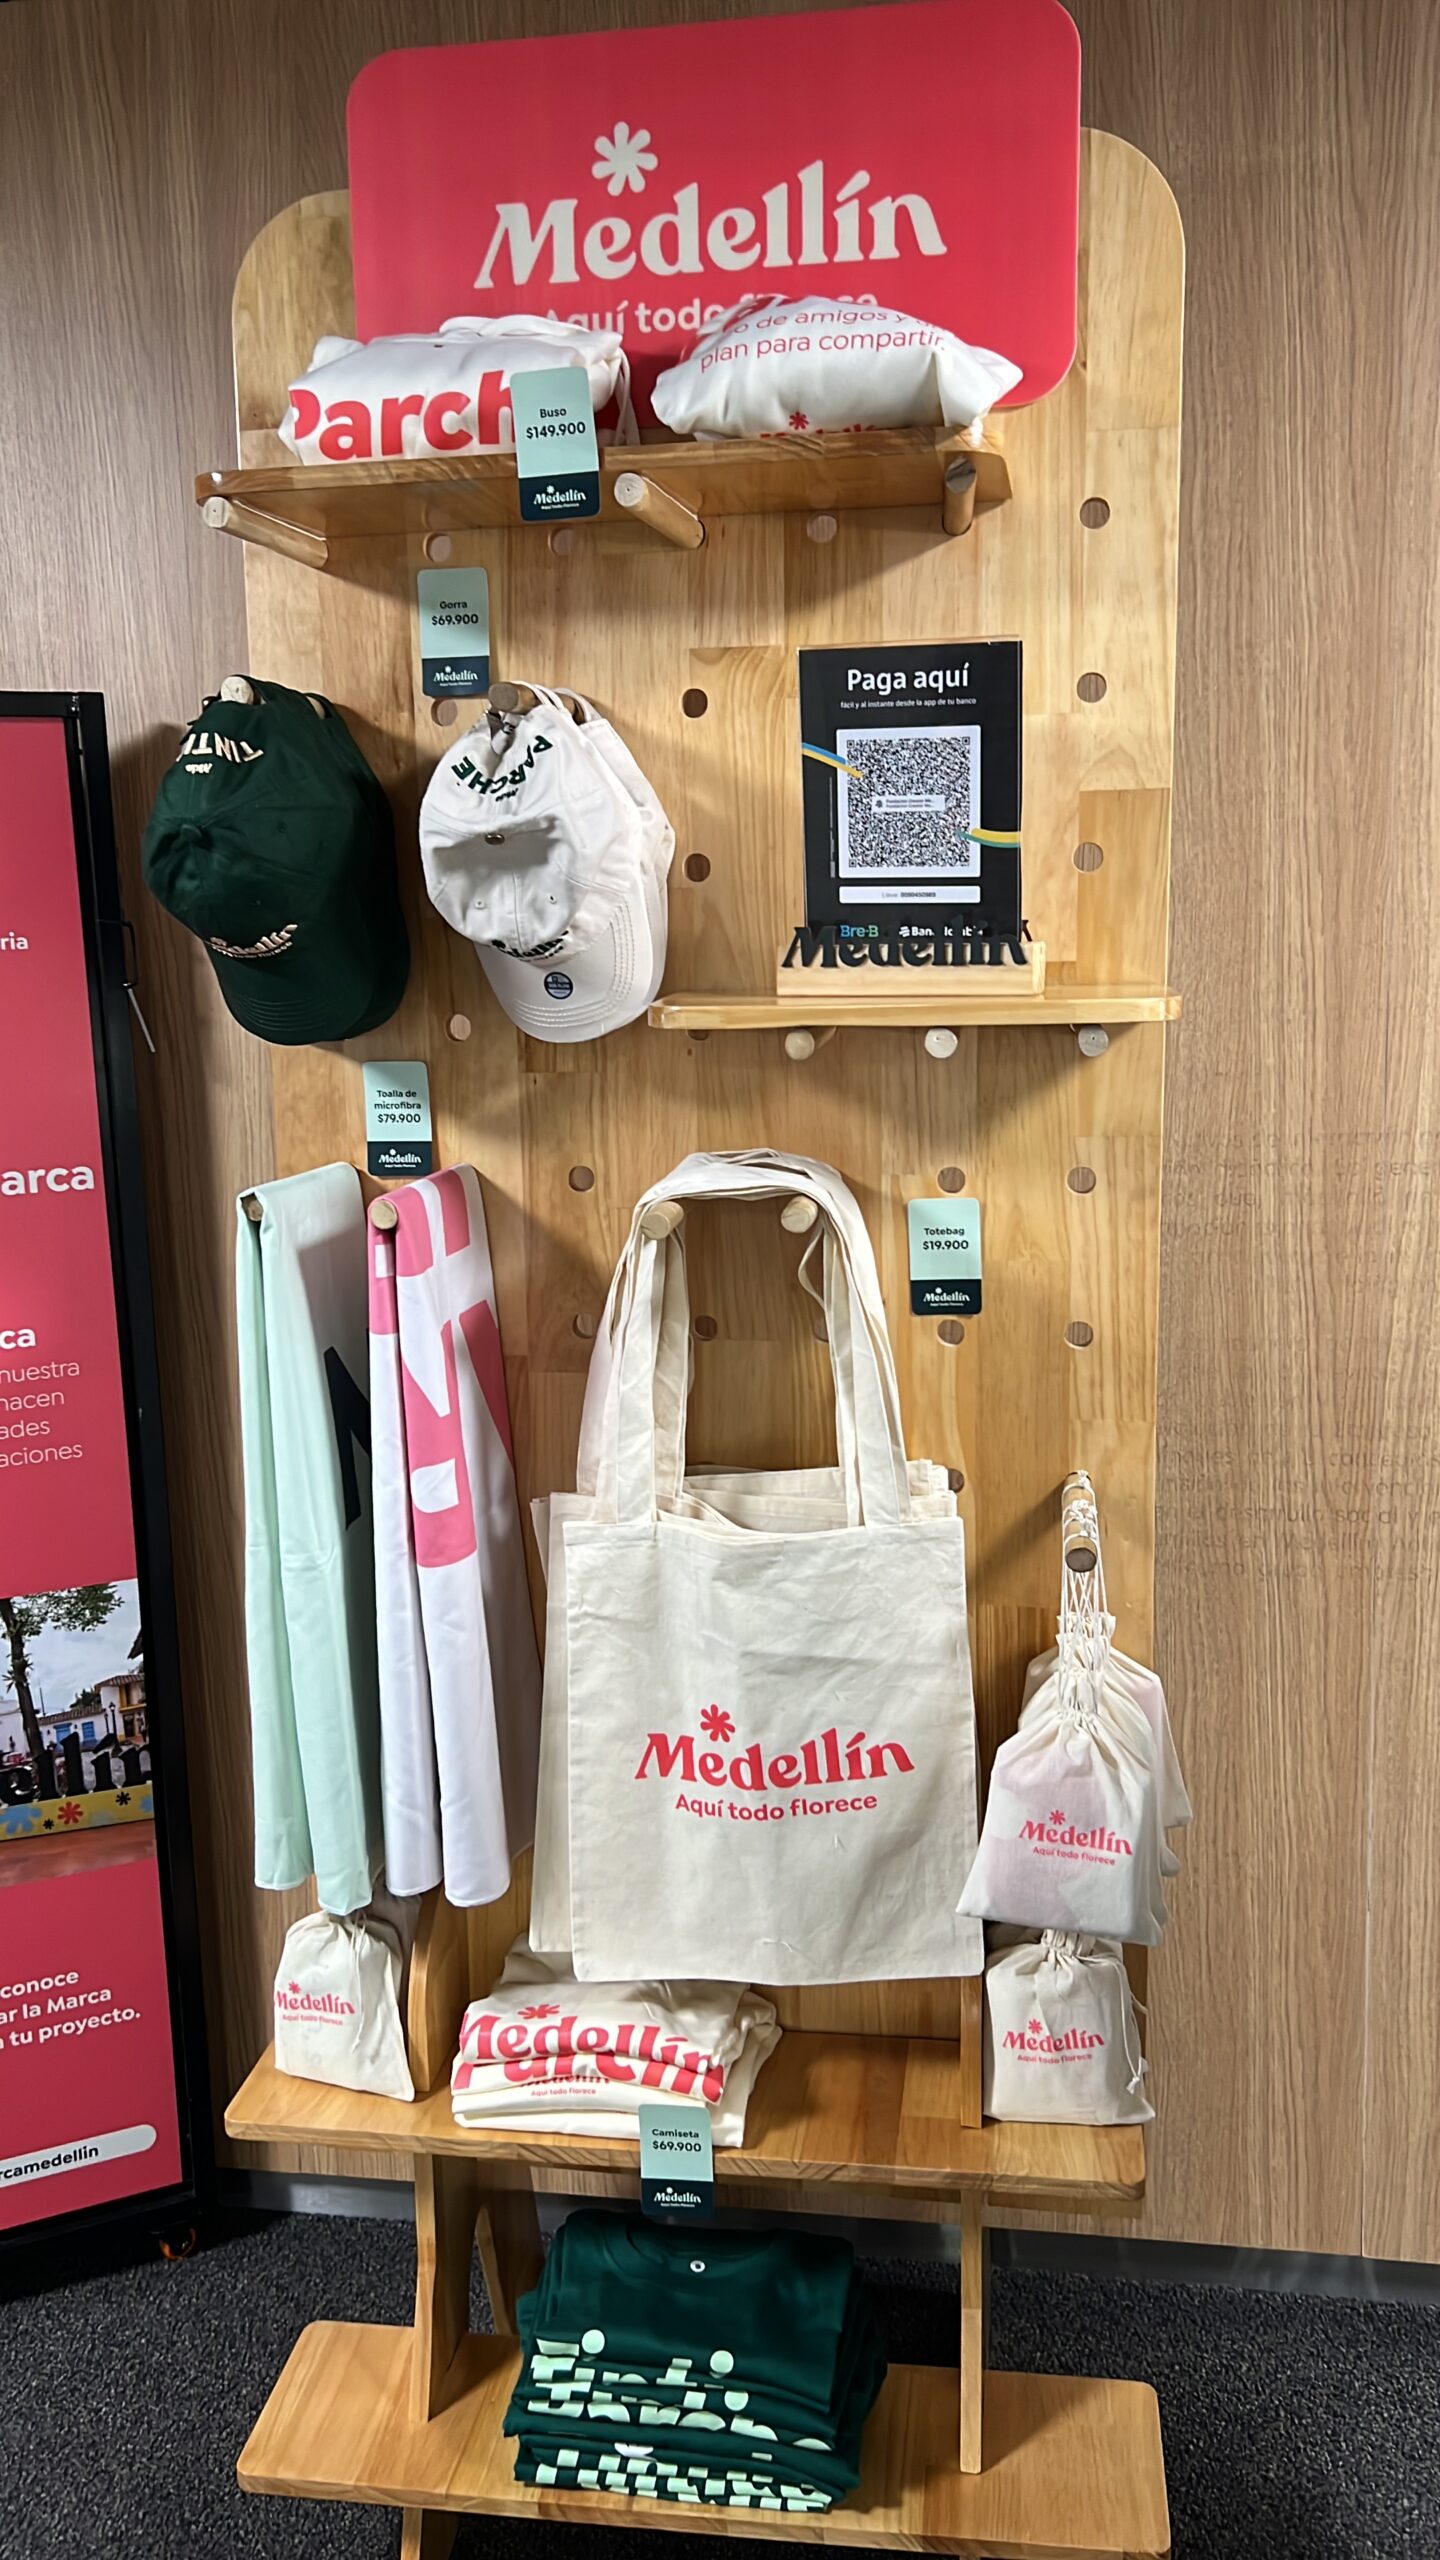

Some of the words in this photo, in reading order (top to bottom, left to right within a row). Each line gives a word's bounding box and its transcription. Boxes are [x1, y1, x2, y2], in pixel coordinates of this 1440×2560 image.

[473, 160, 947, 289] Medellín
[756, 315, 787, 330] de
[795, 308, 887, 325] amigos
[700, 340, 748, 373] plan
[756, 333, 811, 358] para
[818, 329, 946, 352] compartir.
[540, 408, 567, 418] Buso
[526, 421, 586, 439] $149.900
[533, 488, 587, 505] Medellín
[439, 600, 468, 610] Gorra
[431, 613, 479, 626] $69.900
[433, 669, 478, 682] Medellín
[847, 669, 907, 696] Paga
[913, 661, 970, 694] aquí
[839, 925, 879, 938] Bre-B
[376, 1089, 403, 1098] Toalla
[405, 1089, 417, 1098] de
[374, 1101, 422, 1110] microfibra
[378, 1113, 421, 1123] $79.900
[378, 1152, 422, 1164] Medellín
[1, 1166, 95, 1196] arca
[924, 1227, 965, 1236] Totebag
[923, 1240, 969, 1250] $19.900
[923, 1291, 971, 1303] Medellín
[634, 1727, 915, 1791] Medellín
[675, 1793, 723, 1818] Aquí
[728, 1802, 784, 1821] todo
[790, 1795, 878, 1818] florece
[1018, 1820, 1134, 1856] Medellín
[1032, 1846, 1054, 1857] Aquí
[1057, 1849, 1079, 1860] todo
[1081, 1852, 1115, 1866] florece
[0, 1971, 79, 1999] conoce
[22, 2003, 42, 2019] la
[47, 1988, 112, 2013] Marca
[9, 2030, 33, 2046] tu
[39, 2007, 141, 2043] proyecto.
[1002, 2028, 1105, 2053] Medellín
[531, 2088, 549, 2097] Aquí
[549, 2087, 567, 2095] todo
[568, 2087, 597, 2095] florece
[652, 2128, 700, 2138] Camiseta
[652, 2140, 702, 2152] $69.900
[653, 2191, 702, 2204] Medellín
